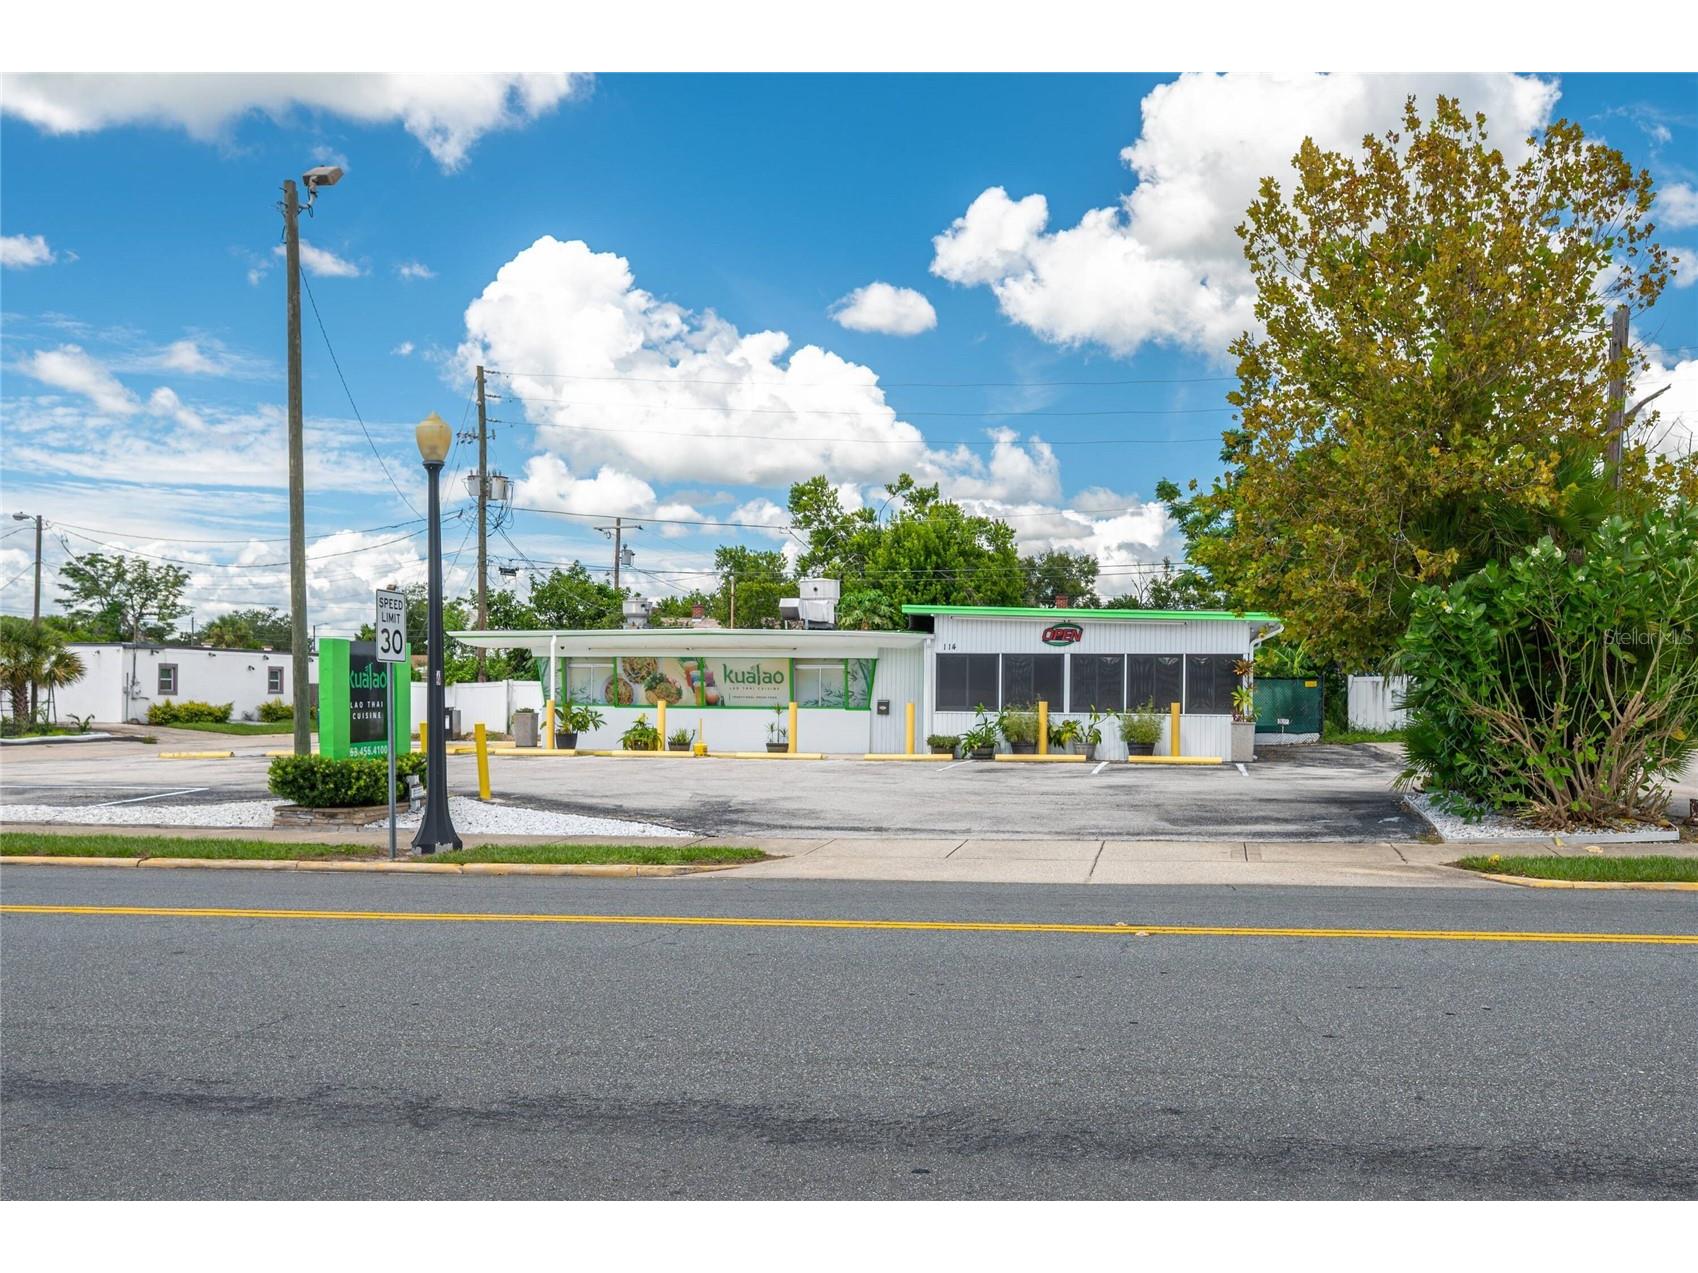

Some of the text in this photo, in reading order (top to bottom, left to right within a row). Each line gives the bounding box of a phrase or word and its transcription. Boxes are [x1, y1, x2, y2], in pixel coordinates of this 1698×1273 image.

[378, 597, 404, 611] SPEED
[381, 612, 401, 625] LIMIT
[380, 628, 403, 655] 30
[1041, 627, 1083, 643] OPEN
[943, 643, 957, 651] 114
[722, 663, 785, 686] kualao
[367, 701, 384, 709] THAI
[352, 711, 382, 720] CUISINE
